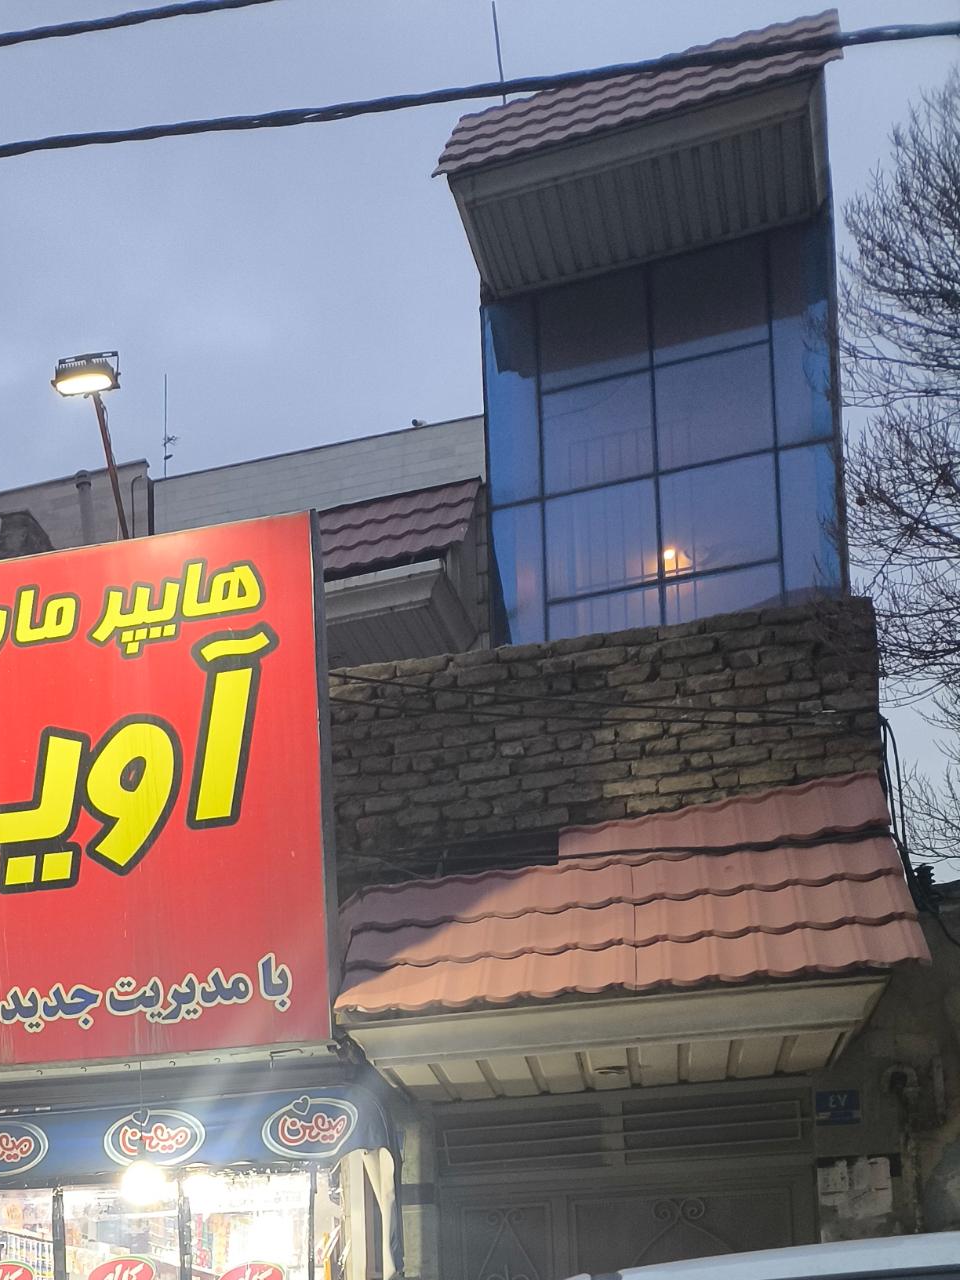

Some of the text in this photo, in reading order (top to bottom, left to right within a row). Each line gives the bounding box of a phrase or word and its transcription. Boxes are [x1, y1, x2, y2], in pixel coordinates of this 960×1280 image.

[86, 559, 264, 657] هایپر
[106, 967, 253, 1024] مدیریت
[258, 952, 292, 1012] با
